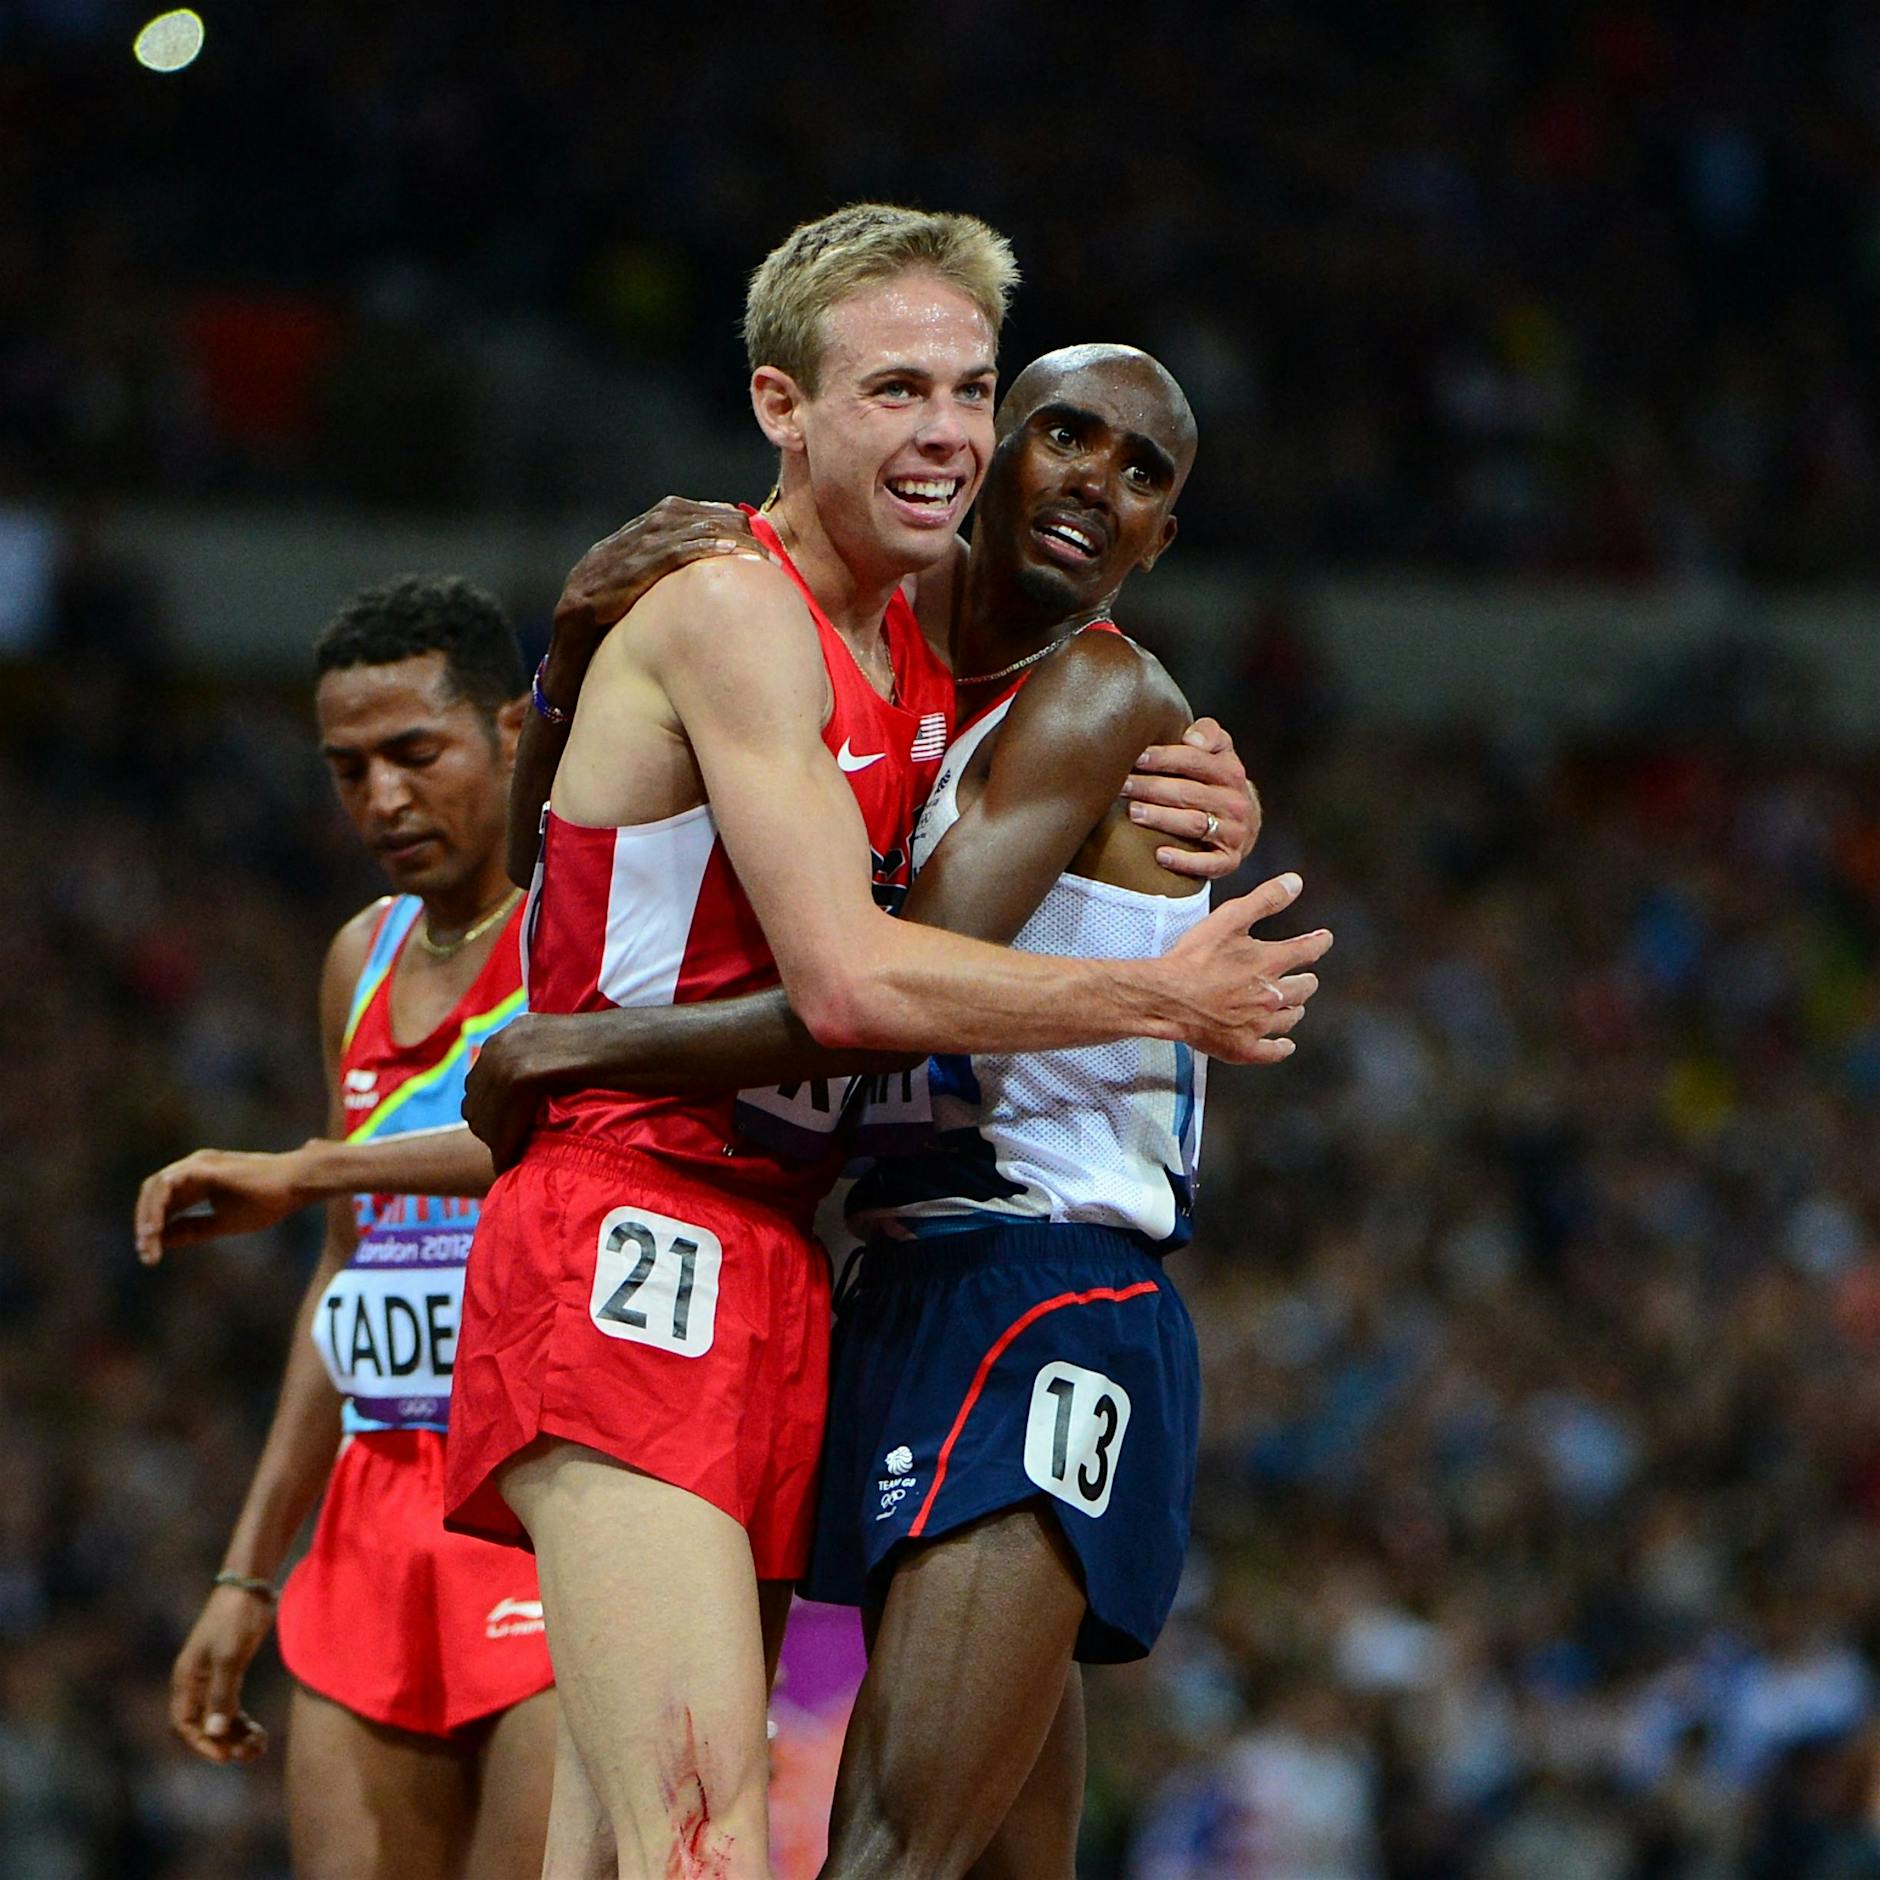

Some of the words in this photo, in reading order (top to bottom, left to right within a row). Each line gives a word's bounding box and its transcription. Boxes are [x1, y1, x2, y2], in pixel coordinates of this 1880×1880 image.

[327, 1293, 457, 1377] TADE
[596, 1221, 699, 1341] 21
[1046, 1376, 1118, 1502] 13
